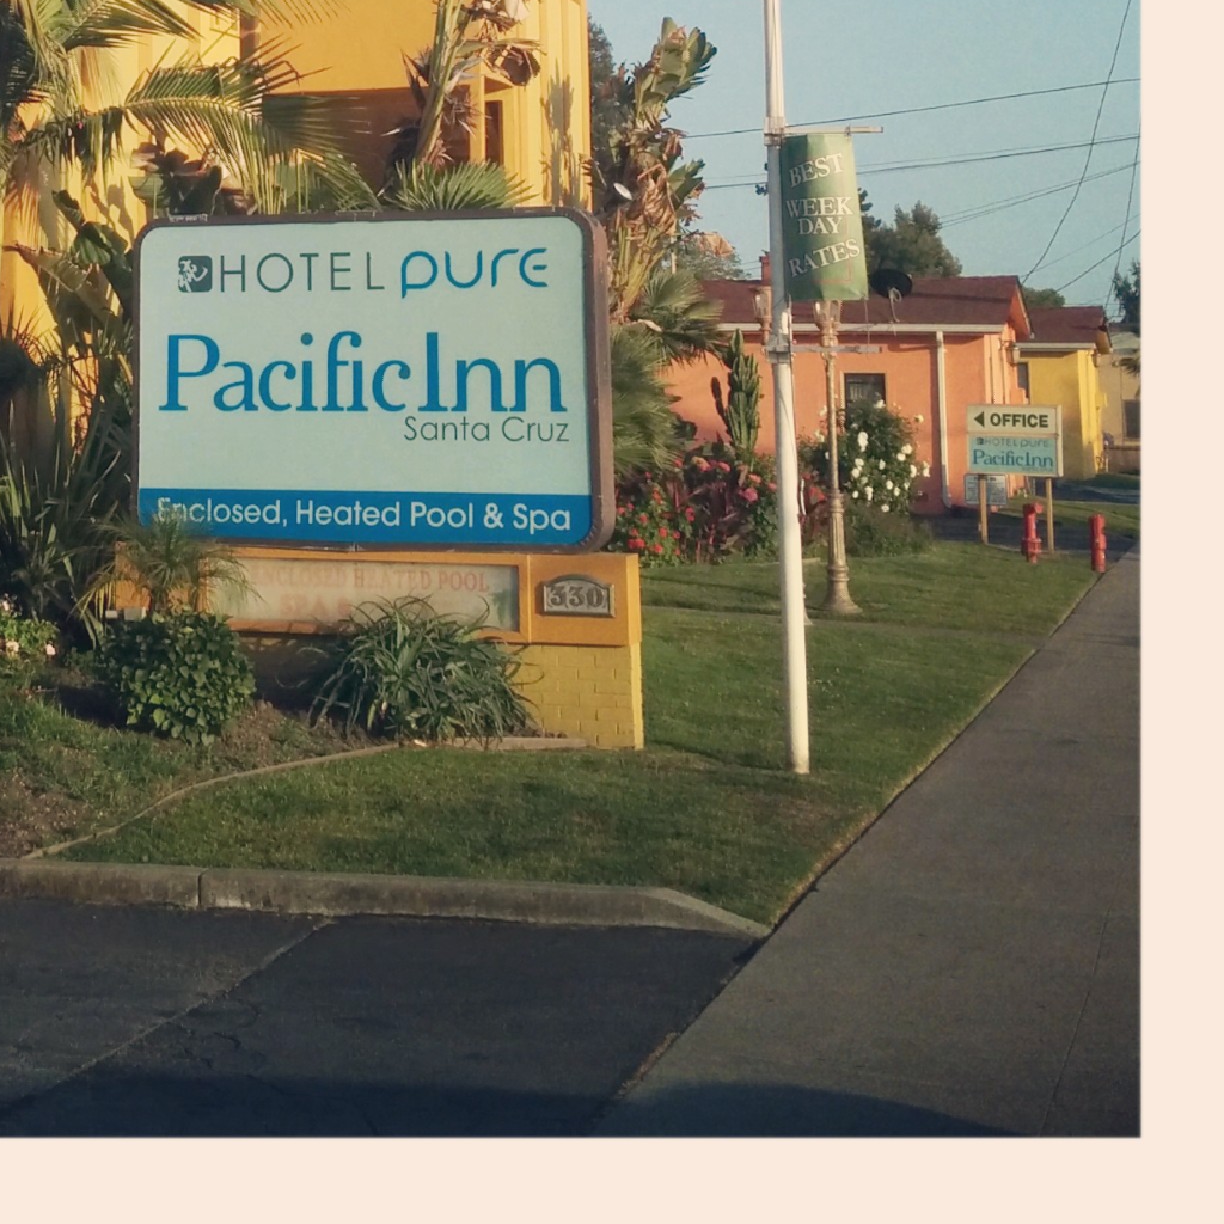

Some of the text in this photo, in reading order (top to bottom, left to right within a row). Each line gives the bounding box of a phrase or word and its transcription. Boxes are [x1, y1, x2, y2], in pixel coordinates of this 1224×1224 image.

[788, 152, 843, 187] BEST
[785, 196, 854, 218] WEEK
[797, 217, 843, 235] DAY
[788, 238, 860, 277] RATES
[219, 251, 386, 294] HOTEL
[403, 415, 570, 442] Santa Cruz
[989, 413, 1049, 429] OFFICE
[984, 438, 1018, 448] HOTEL
[157, 496, 571, 535] Enclosed, Heated Pool & Spa
[437, 570, 490, 593] POOL
[550, 585, 604, 608] 330
